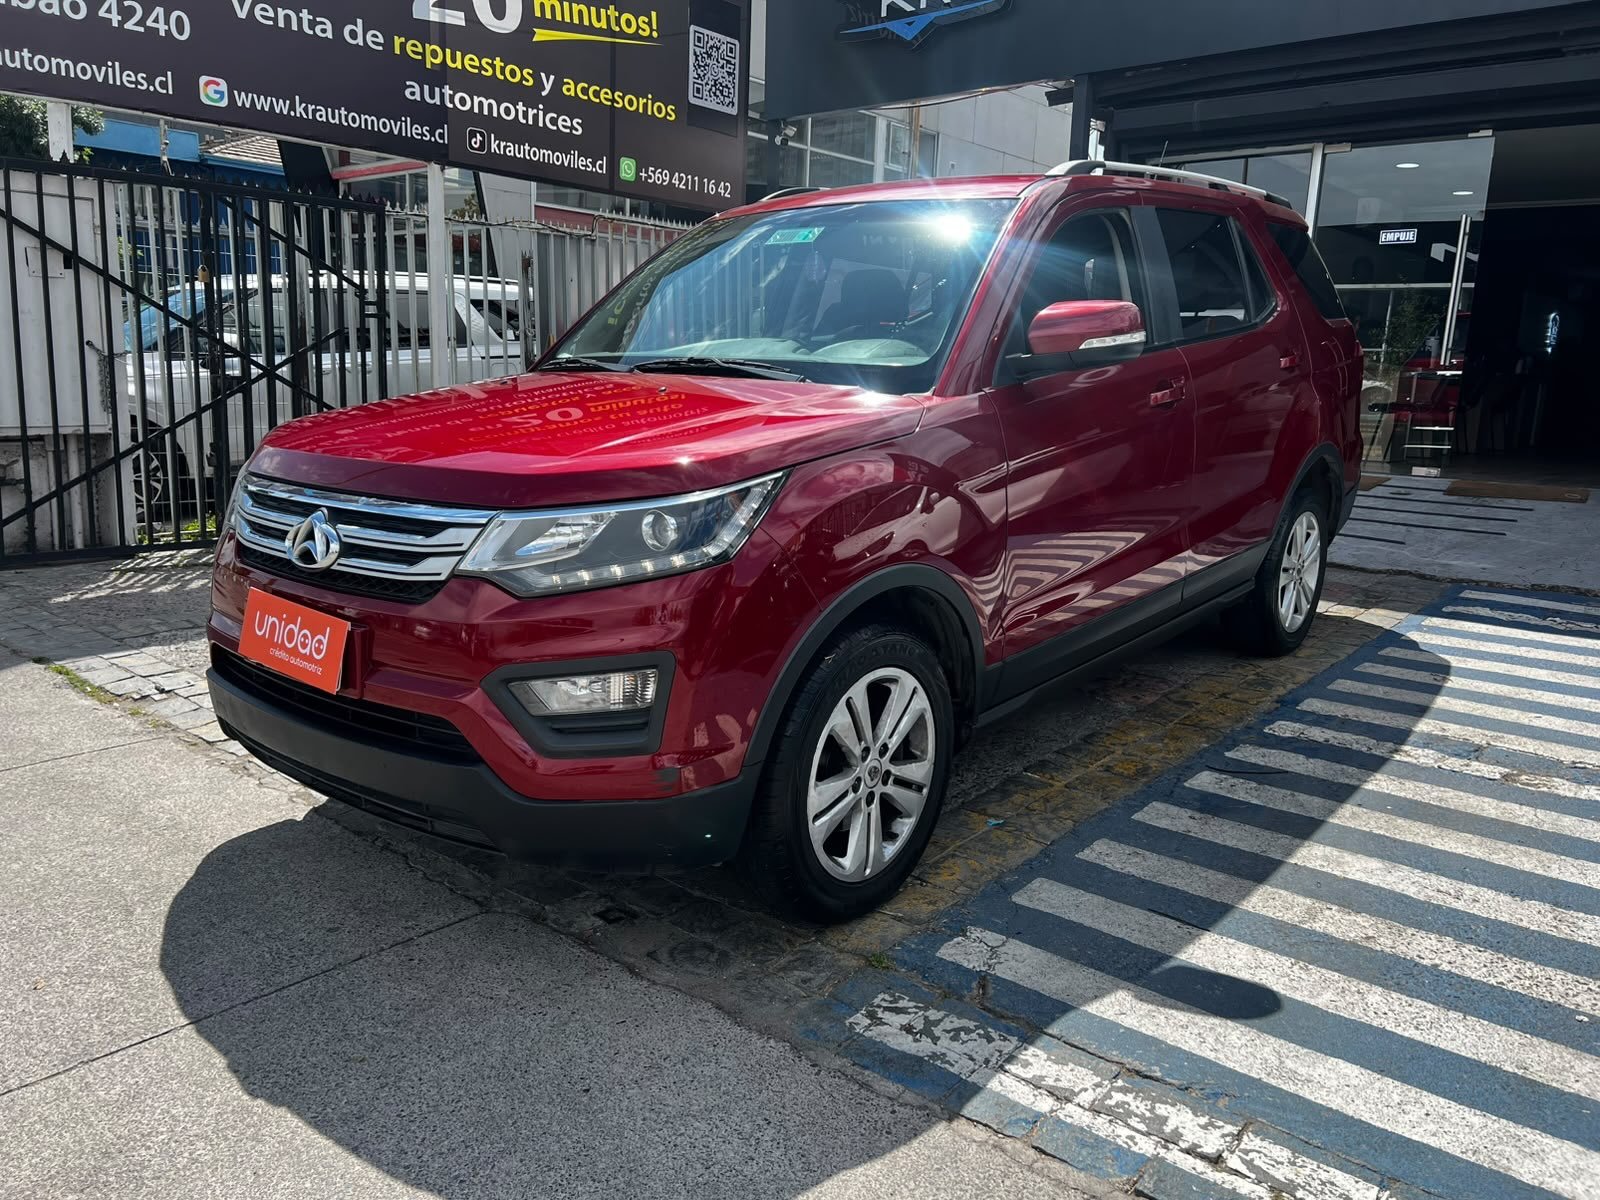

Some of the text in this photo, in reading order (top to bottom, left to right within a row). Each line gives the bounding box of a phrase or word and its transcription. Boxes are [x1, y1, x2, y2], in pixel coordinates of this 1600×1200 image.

[0, 0, 191, 41] ao 4240
[533, 0, 659, 38] minutos!
[0, 48, 173, 95] utomoviles.cl
[231, 0, 676, 121] Venta de repuestos y accesorios
[233, 88, 449, 145] www.krautomoviles.cl
[404, 80, 583, 136] automotrices
[490, 133, 607, 175] krautomoviles.cl
[639, 166, 731, 198] +569 4211 16 42
[1381, 232, 1415, 242] EMPUJE
[254, 610, 330, 660] unidad
[269, 646, 323, 676] crédito automotriz
